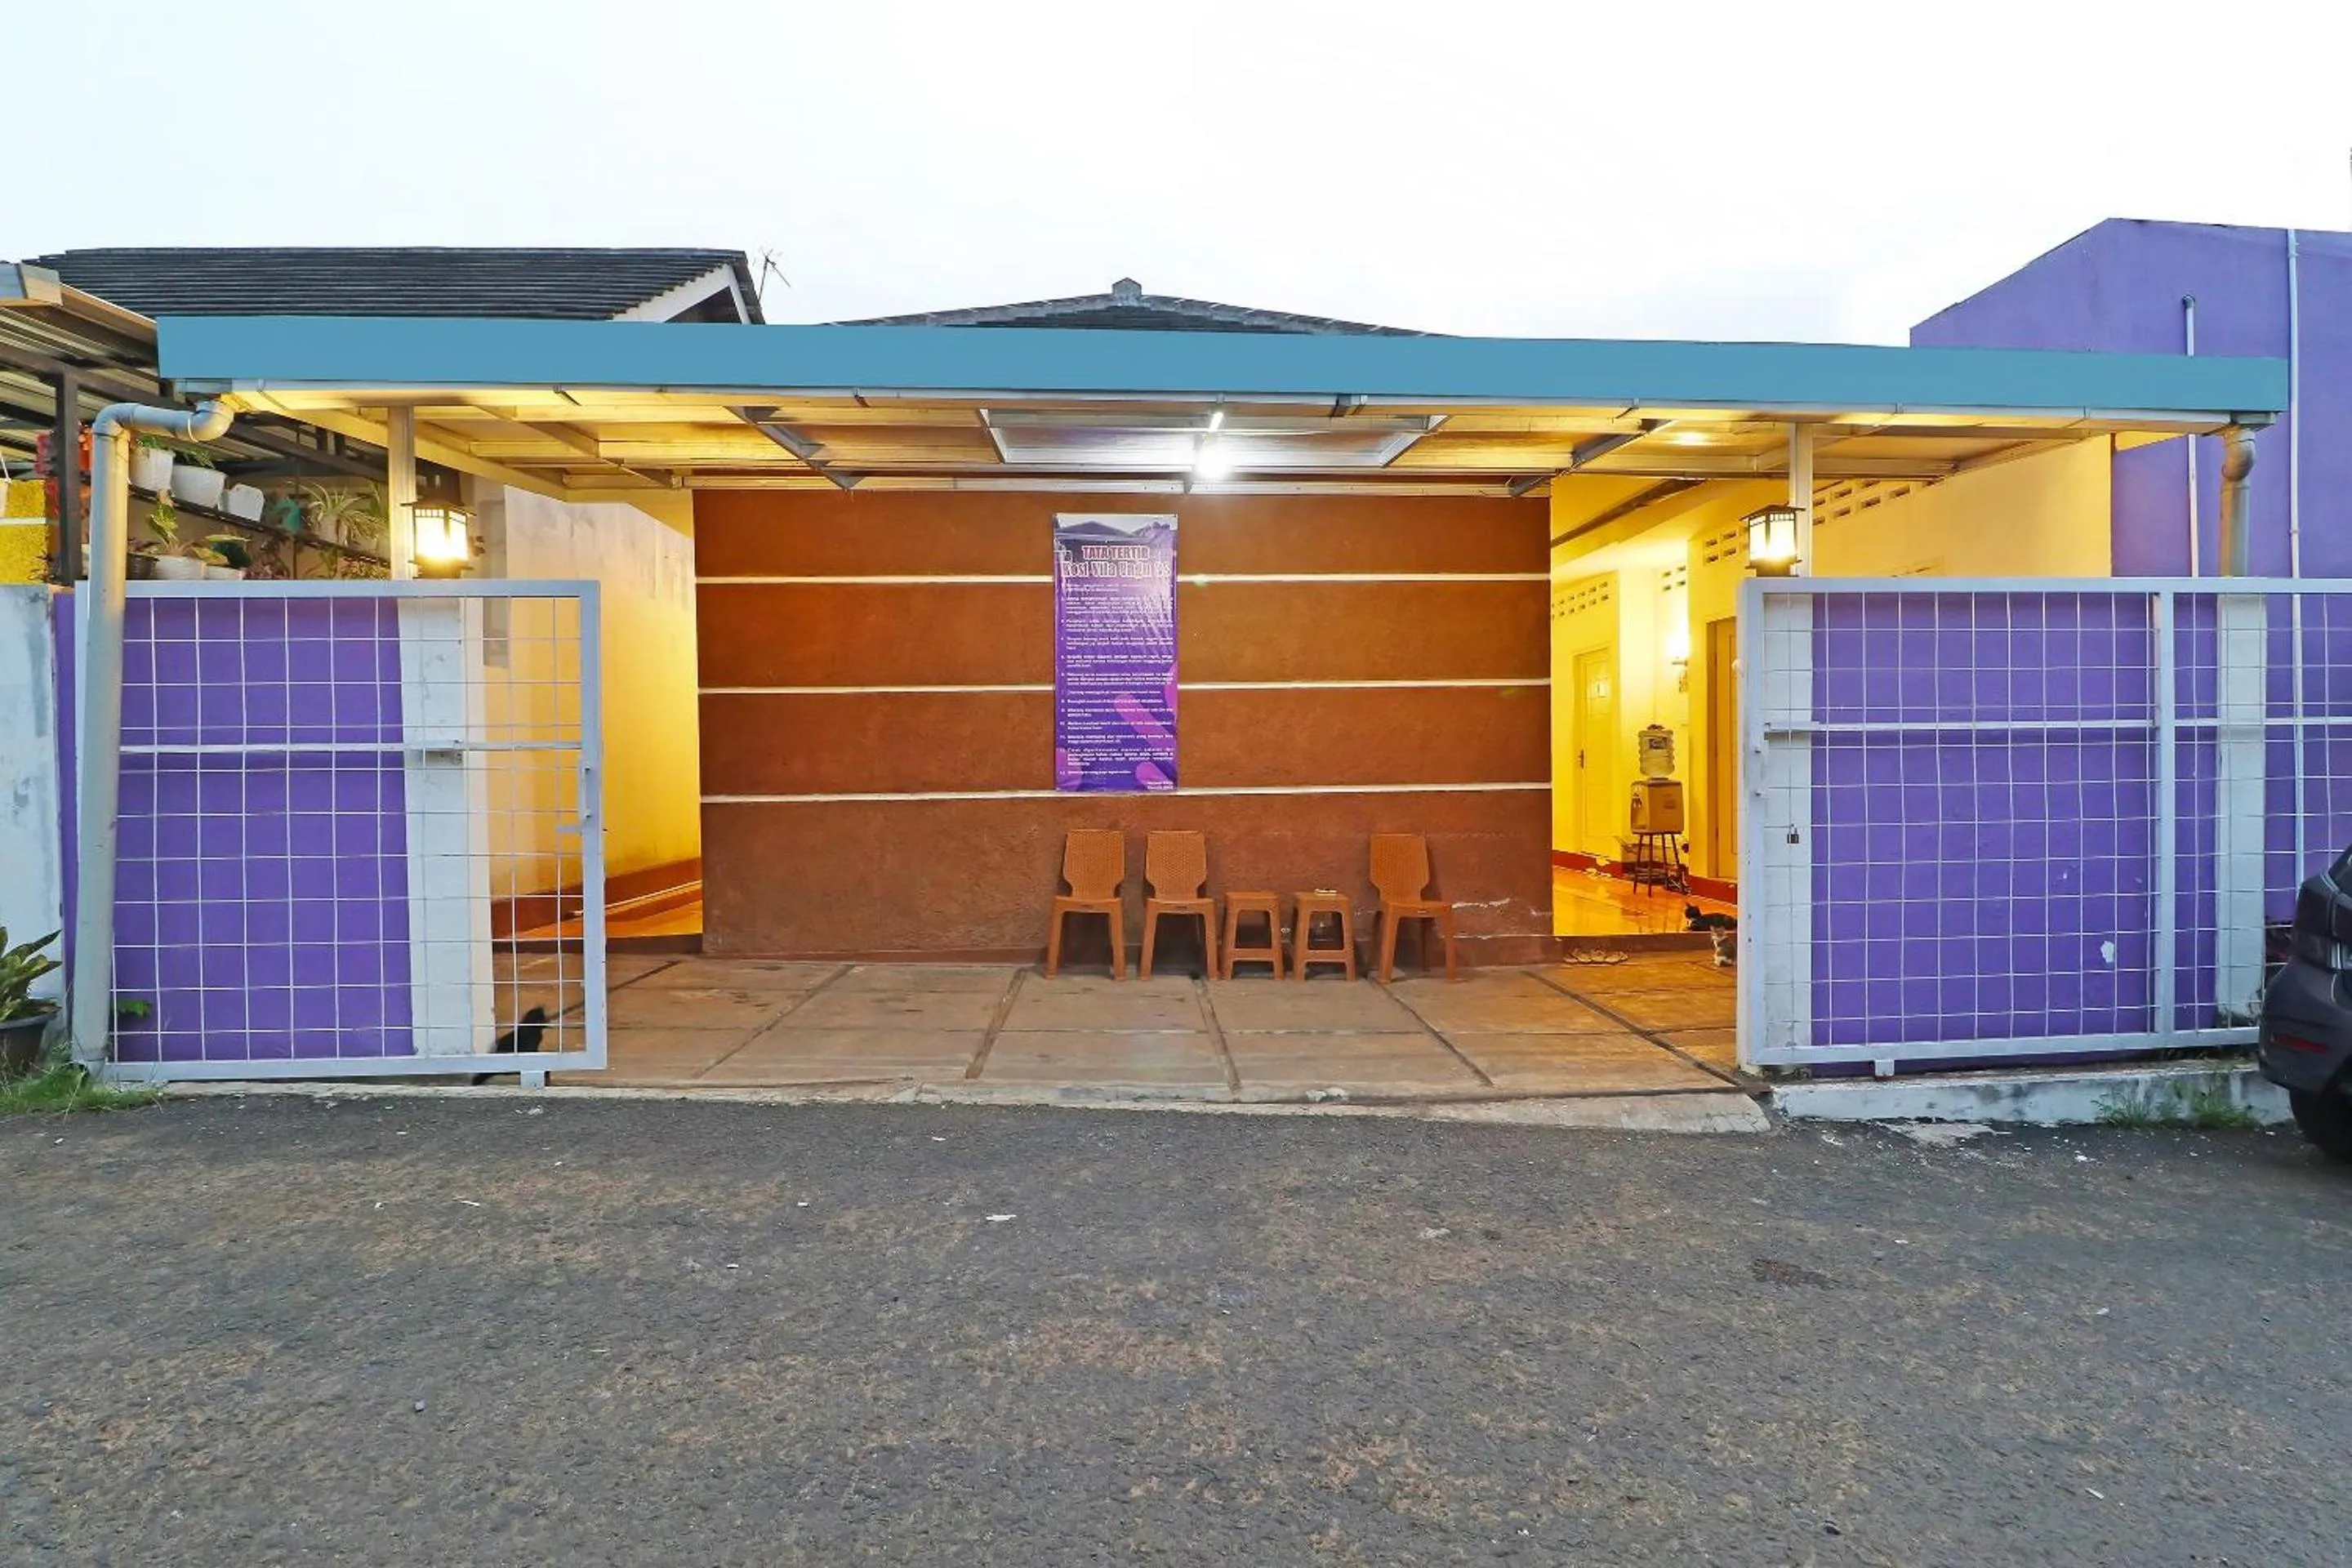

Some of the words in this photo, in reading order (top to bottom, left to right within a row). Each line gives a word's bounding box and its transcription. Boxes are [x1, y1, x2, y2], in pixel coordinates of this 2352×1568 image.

[1082, 546, 1109, 559] TATA
[1111, 546, 1150, 560] TERTIB
[1062, 562, 1089, 577] Kost
